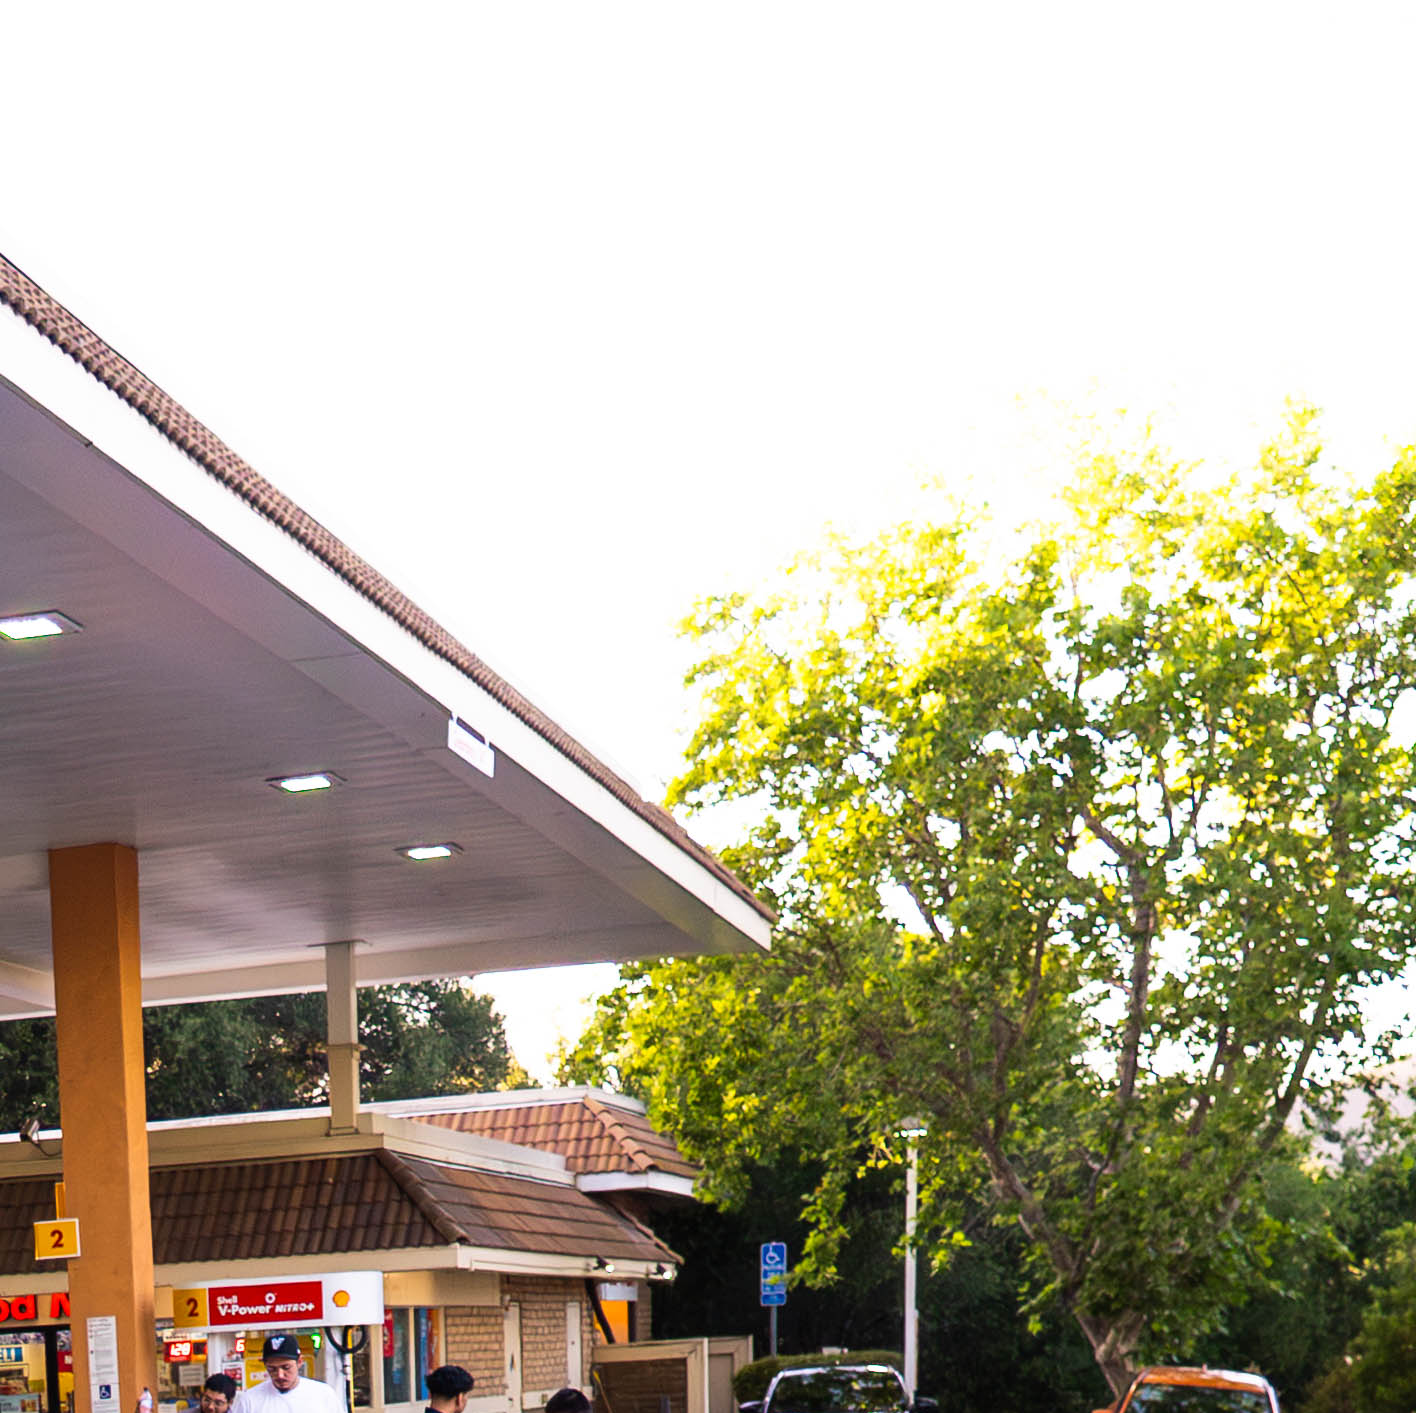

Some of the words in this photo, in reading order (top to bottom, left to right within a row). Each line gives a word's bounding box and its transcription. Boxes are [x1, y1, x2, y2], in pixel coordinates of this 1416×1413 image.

[50, 1230, 64, 1248] 2
[217, 1295, 238, 1304] Shell
[186, 1298, 199, 1317] 2
[218, 1304, 272, 1316] V-Power
